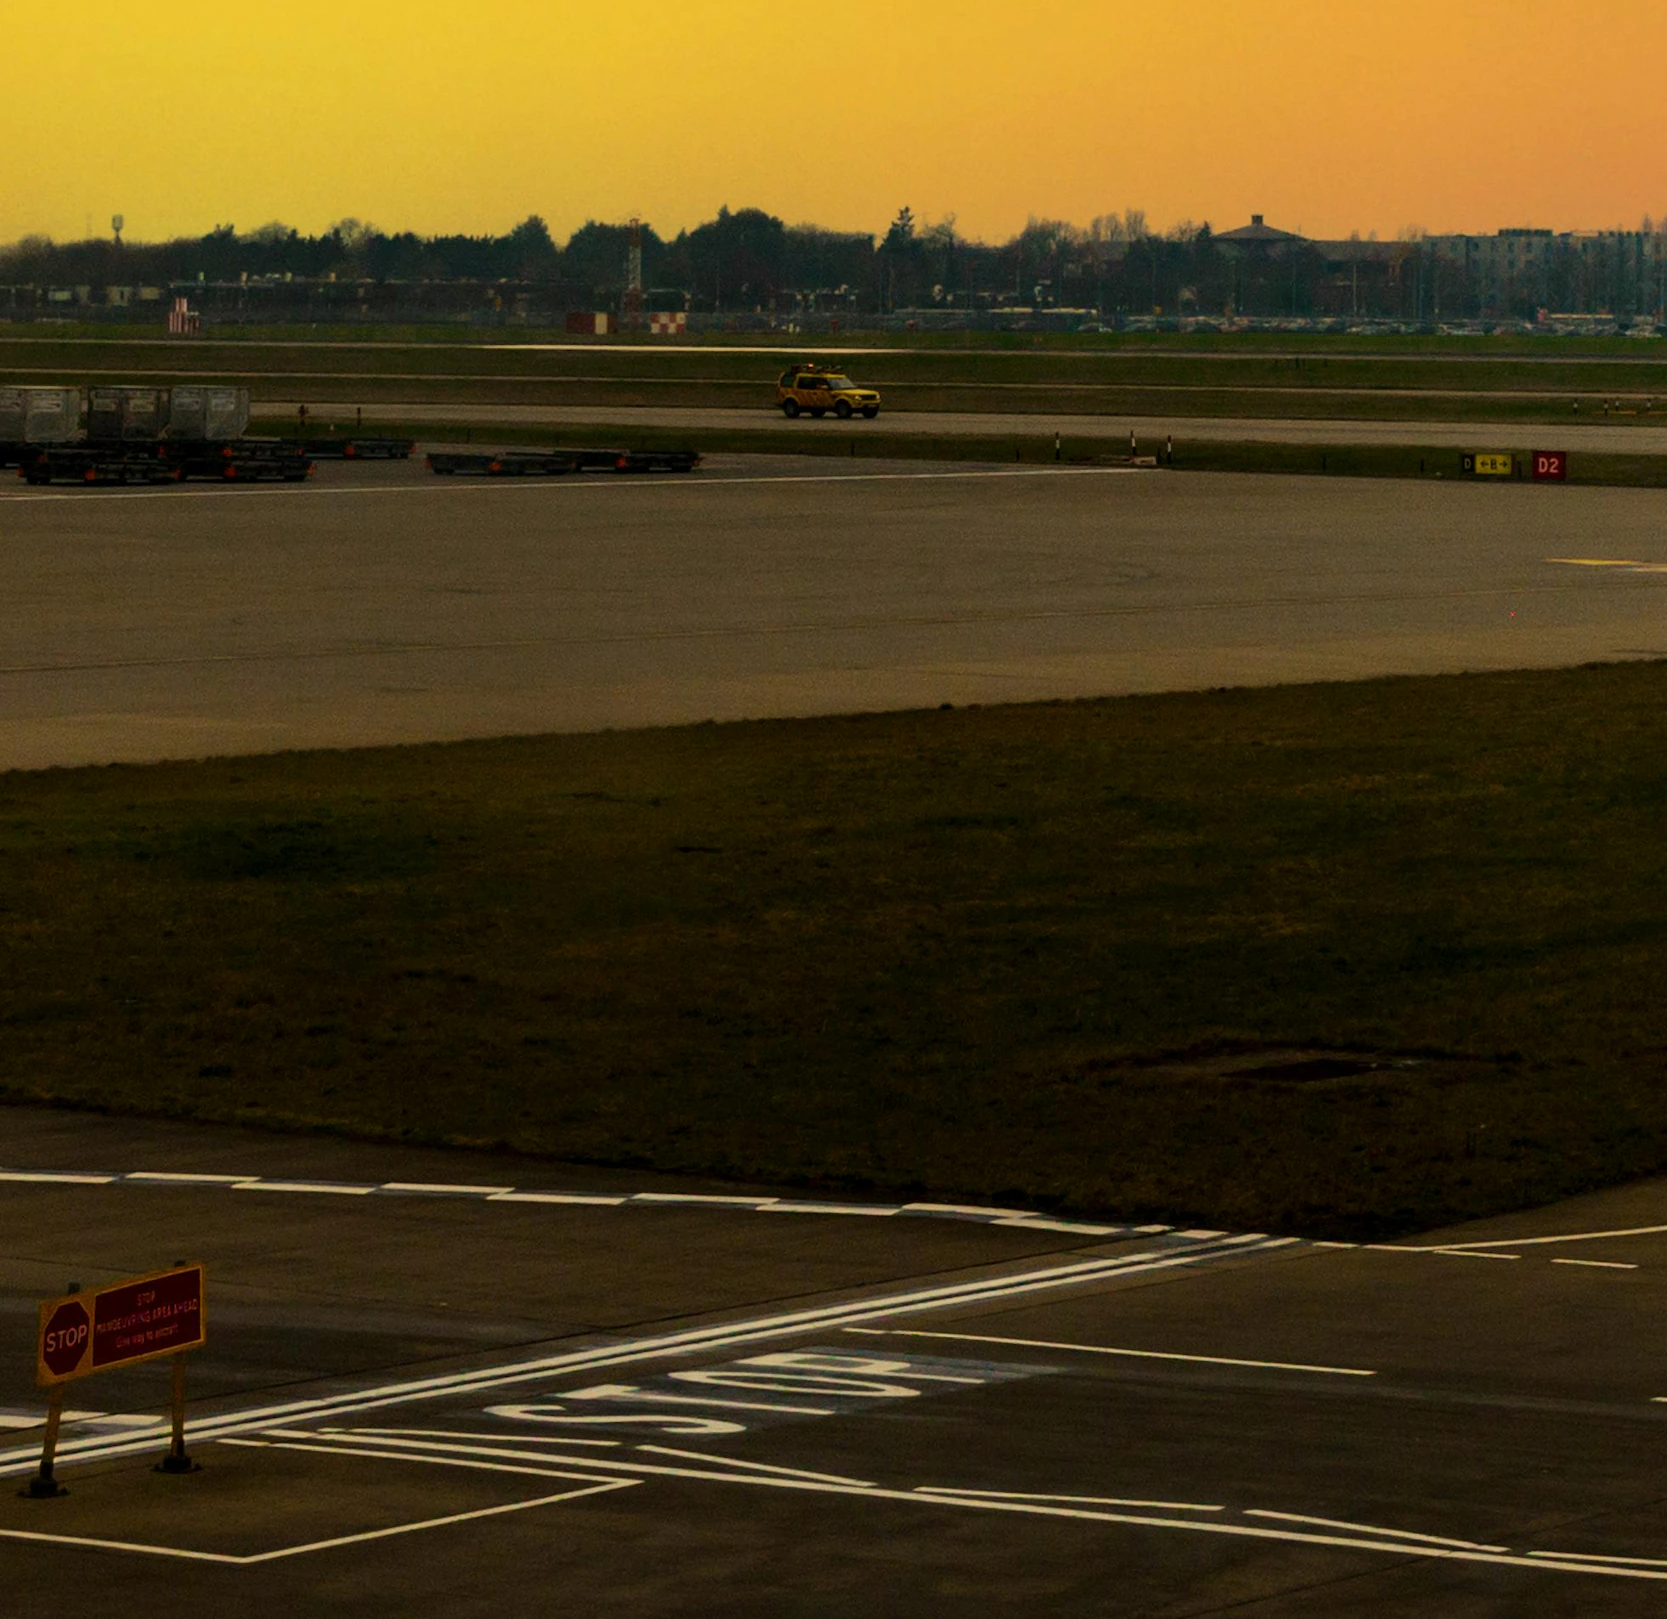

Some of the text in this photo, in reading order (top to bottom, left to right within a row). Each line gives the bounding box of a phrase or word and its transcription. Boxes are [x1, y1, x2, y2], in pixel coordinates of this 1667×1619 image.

[1465, 458, 1471, 468] D
[1491, 459, 1497, 470] B
[1538, 457, 1559, 473] D2
[137, 1291, 156, 1306] STOP
[96, 1299, 198, 1333] MANOEUVRING AREA AHEAD
[47, 1325, 88, 1352] STOP
[482, 1352, 986, 1435] STOP
